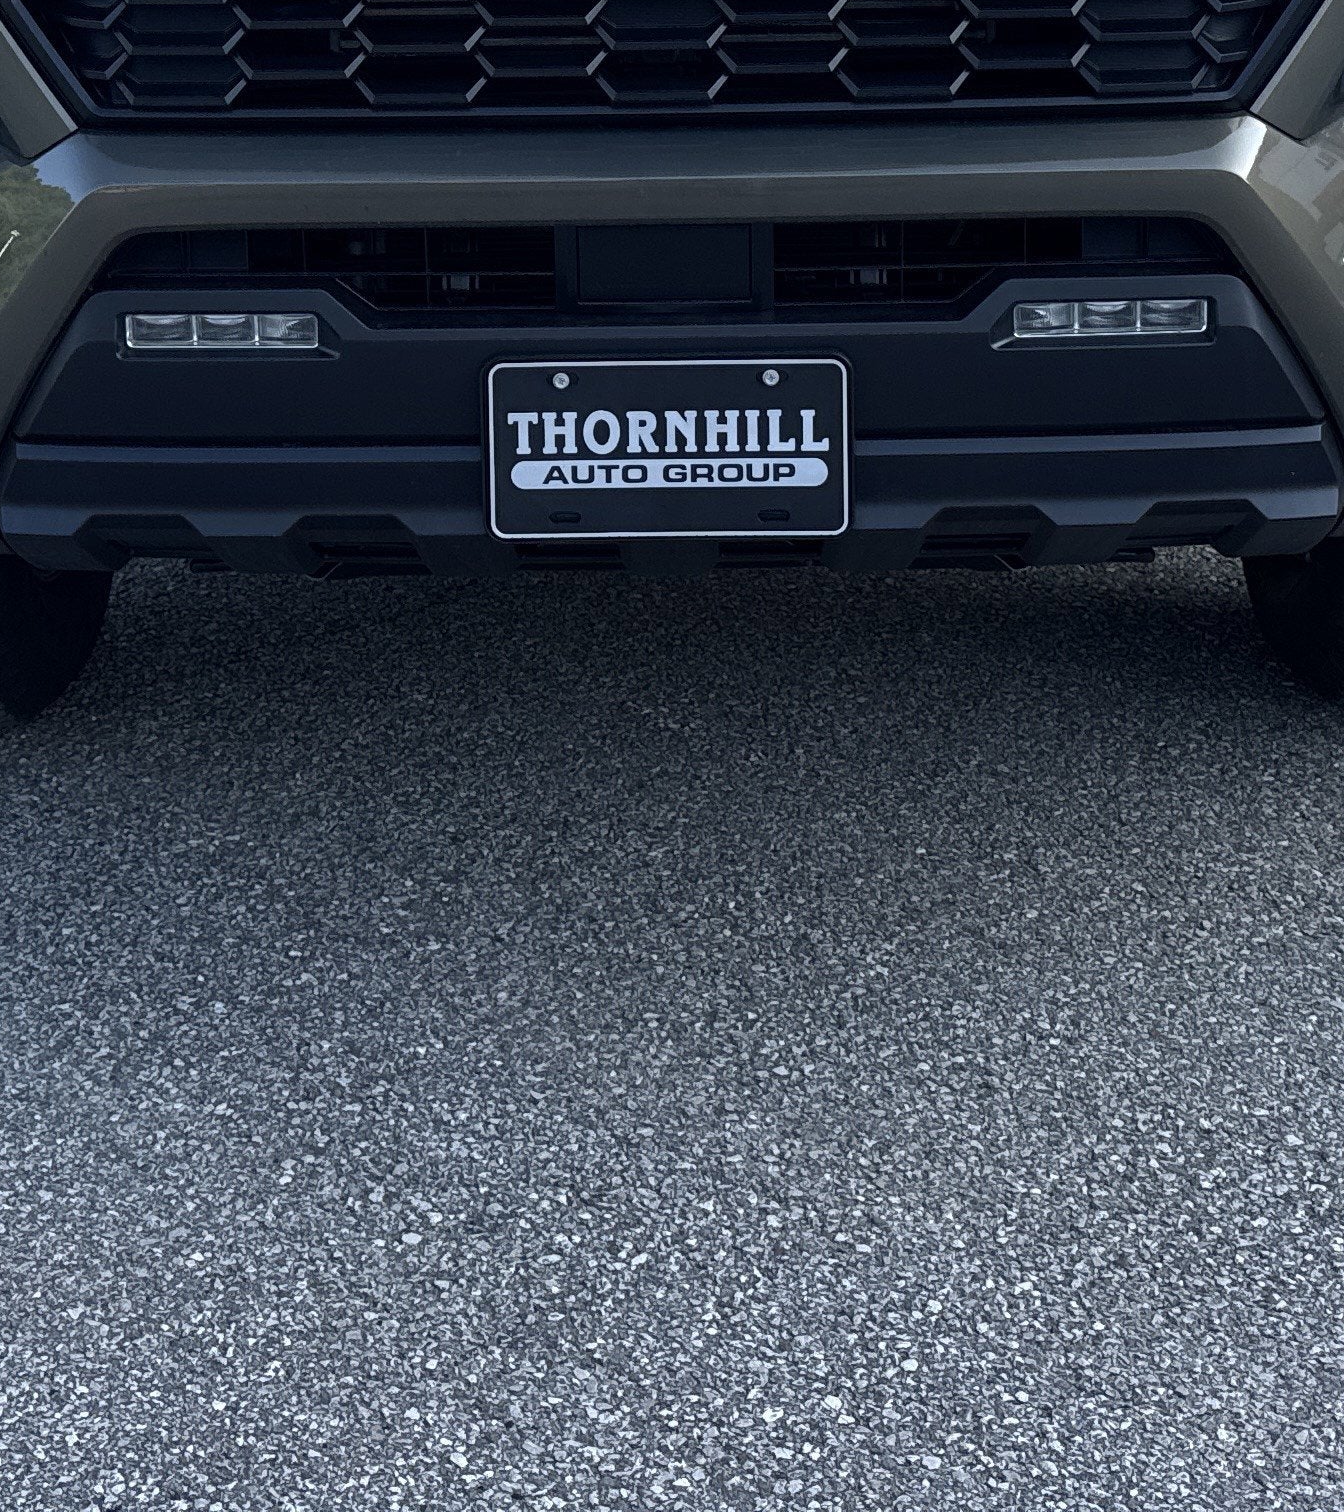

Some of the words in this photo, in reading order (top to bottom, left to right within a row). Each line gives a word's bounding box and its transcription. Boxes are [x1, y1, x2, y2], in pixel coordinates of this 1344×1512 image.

[507, 409, 829, 455] THORNHILL
[543, 464, 648, 485] AUTO
[663, 463, 796, 483] GROUP
